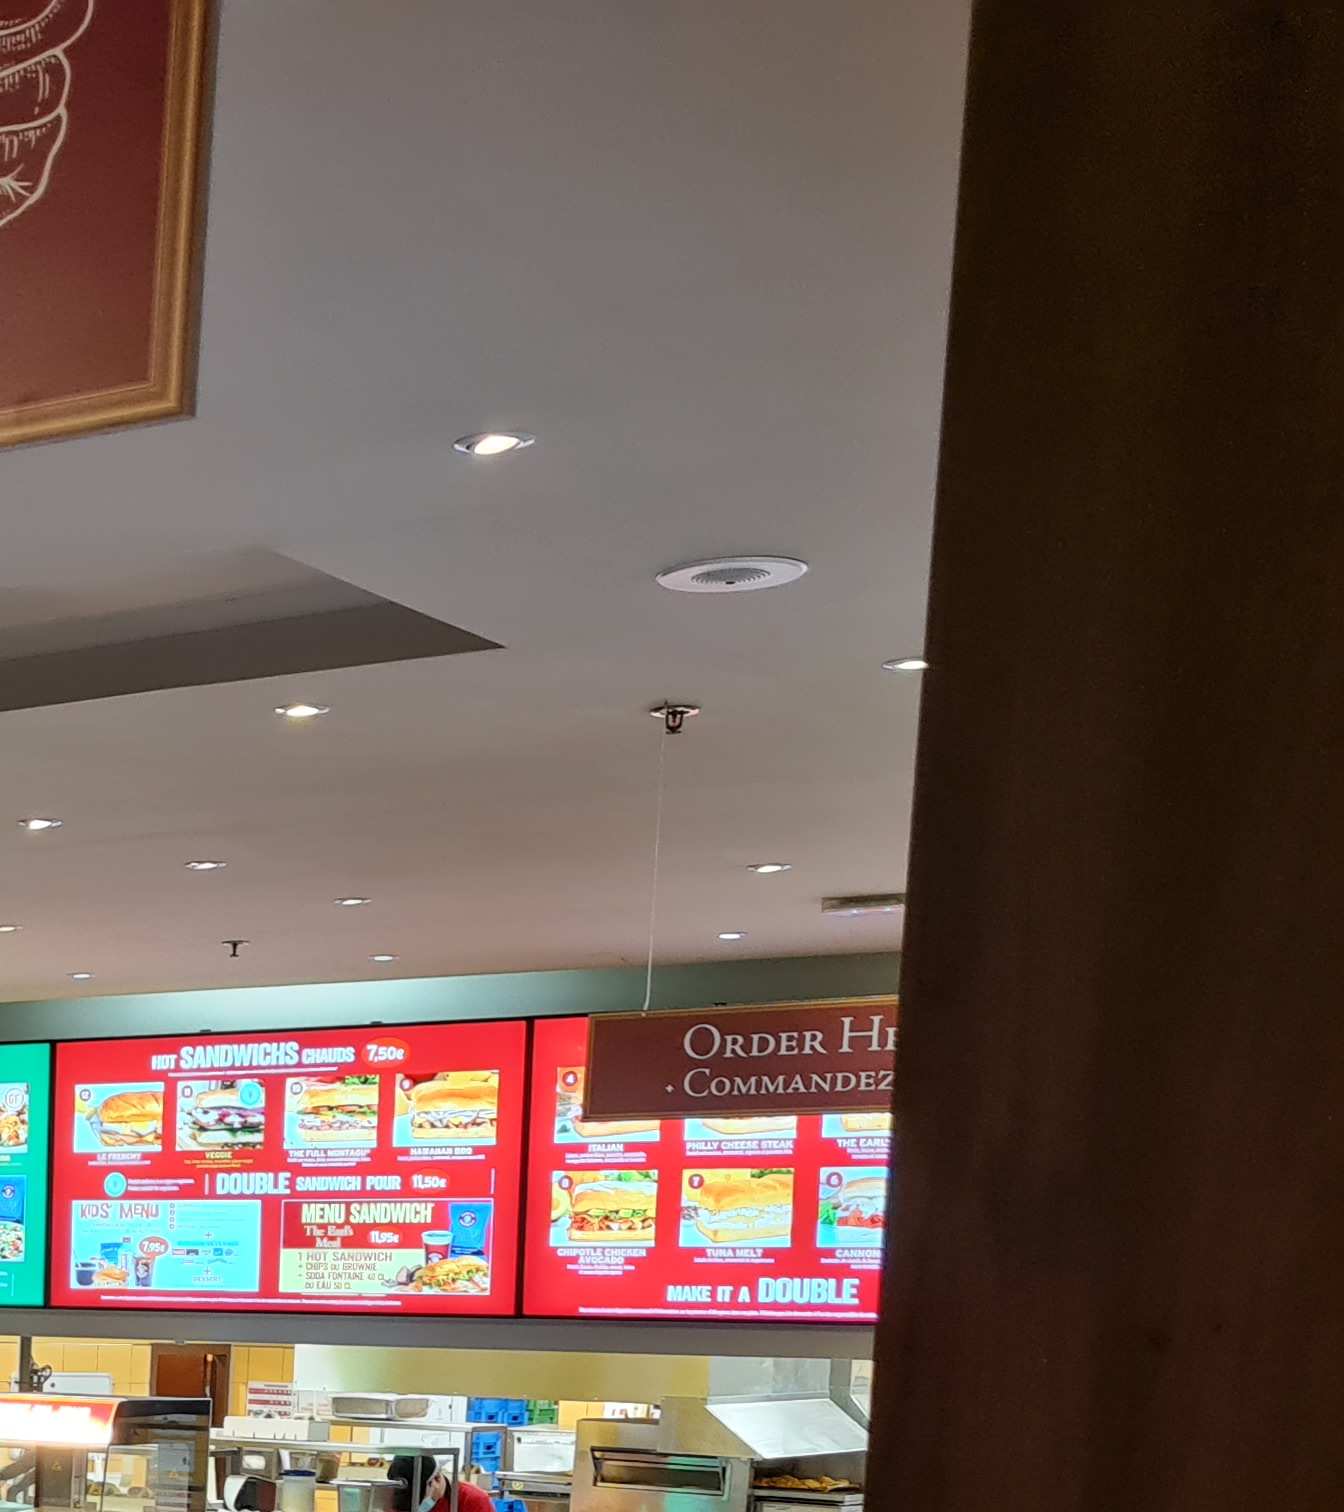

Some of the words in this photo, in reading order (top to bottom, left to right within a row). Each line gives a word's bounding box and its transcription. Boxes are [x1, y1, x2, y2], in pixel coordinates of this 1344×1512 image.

[683, 1023, 827, 1060] ORDER
[151, 1055, 177, 1070] HOT
[180, 1042, 300, 1069] SANDWICHS
[301, 1047, 355, 1065] CHAUDS
[565, 1074, 575, 1084] 4
[683, 1067, 894, 1098] COMMANDEZ
[588, 1144, 624, 1152] ITALIAN
[685, 1142, 717, 1151] PHILLY
[721, 1141, 758, 1150] CHEESE
[761, 1140, 794, 1149] STEAK
[837, 1139, 857, 1148] THE
[216, 1172, 291, 1195] DOUBLE
[296, 1176, 361, 1191] SANDWICH
[366, 1175, 401, 1190] POUR
[119, 1203, 159, 1219] MENU
[301, 1203, 345, 1224] MENU
[349, 1203, 433, 1223] SANDWICH
[297, 1252, 303, 1261] 1
[306, 1252, 329, 1261] HOT
[332, 1252, 392, 1261] SANDWICH
[557, 1249, 597, 1257] CHIPOTLE
[600, 1248, 646, 1257] CHICKEN
[706, 1248, 732, 1258] TUNA
[736, 1248, 763, 1257] MELT
[578, 1256, 625, 1265] AVOCADO
[305, 1262, 328, 1271] CHIPS
[316, 1281, 331, 1289] EAU
[666, 1285, 712, 1302] MAKE
[717, 1286, 732, 1302] IT
[737, 1286, 751, 1302] A
[757, 1278, 860, 1304] DOUBLE
